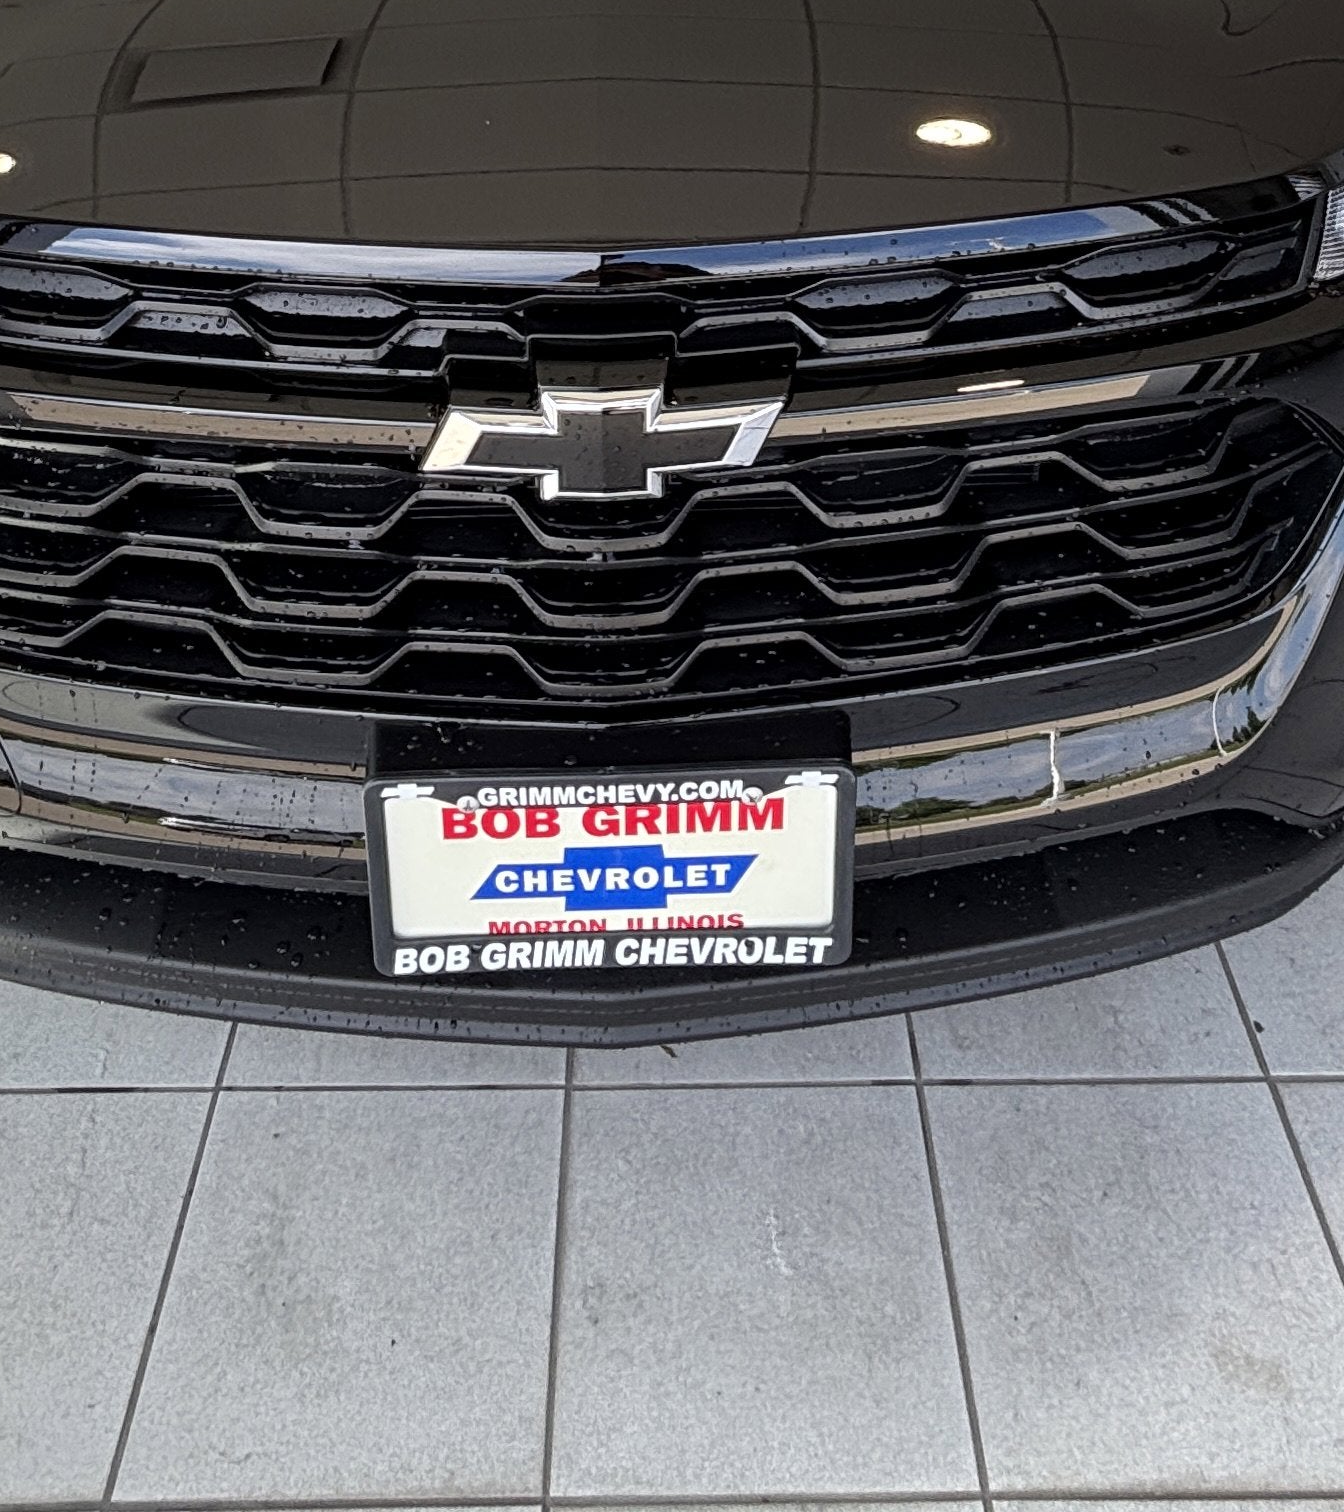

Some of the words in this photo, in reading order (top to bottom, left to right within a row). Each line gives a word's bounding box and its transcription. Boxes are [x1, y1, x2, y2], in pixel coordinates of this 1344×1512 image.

[476, 779, 744, 807] GRIMMCHEVY.COM
[441, 806, 561, 840] BOB
[581, 796, 785, 837] GRIMM
[494, 862, 733, 894] CHEVROLET
[488, 919, 607, 936] MORTON
[393, 944, 471, 977] BOB
[480, 939, 606, 971] GRIMM
[615, 936, 833, 967] CHEVROLET
